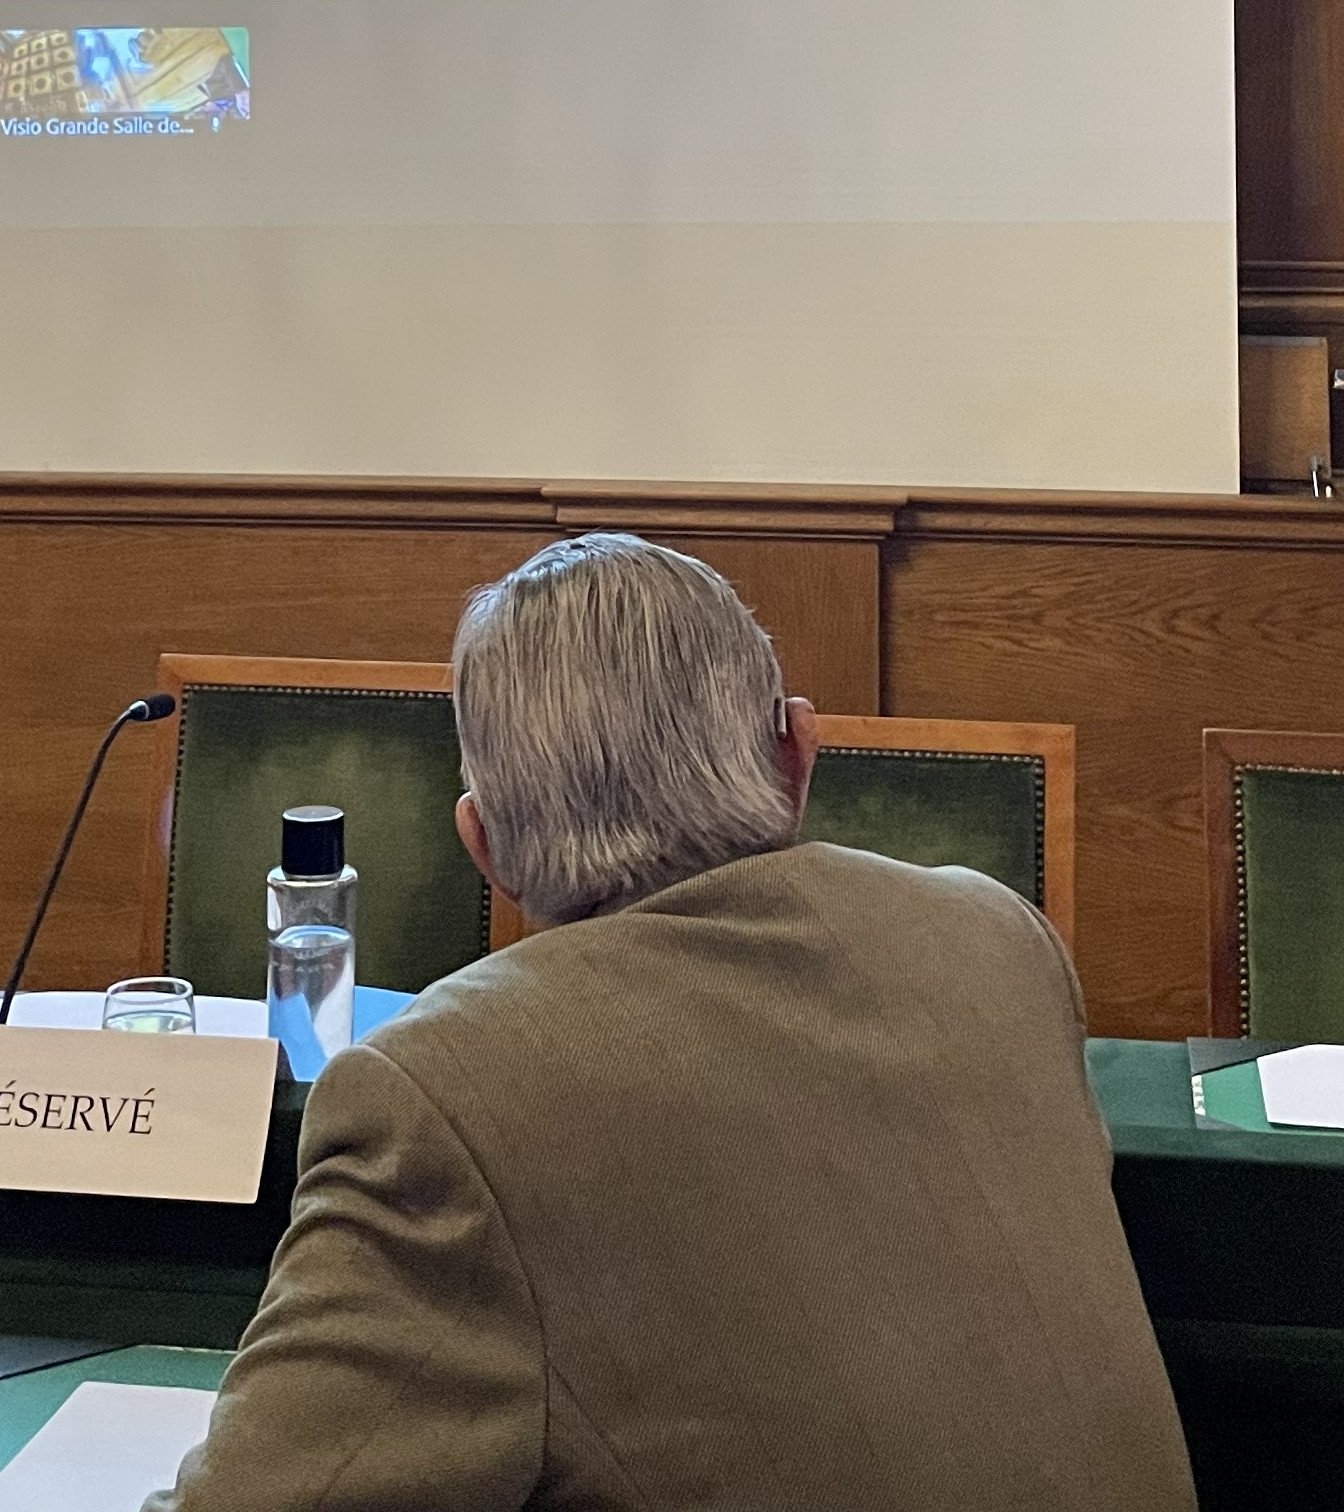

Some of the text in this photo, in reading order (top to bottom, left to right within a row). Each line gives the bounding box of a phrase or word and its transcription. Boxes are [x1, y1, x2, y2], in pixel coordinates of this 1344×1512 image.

[0, 117, 42, 136] Visio
[45, 116, 109, 135] Grande
[112, 115, 154, 135] Salle
